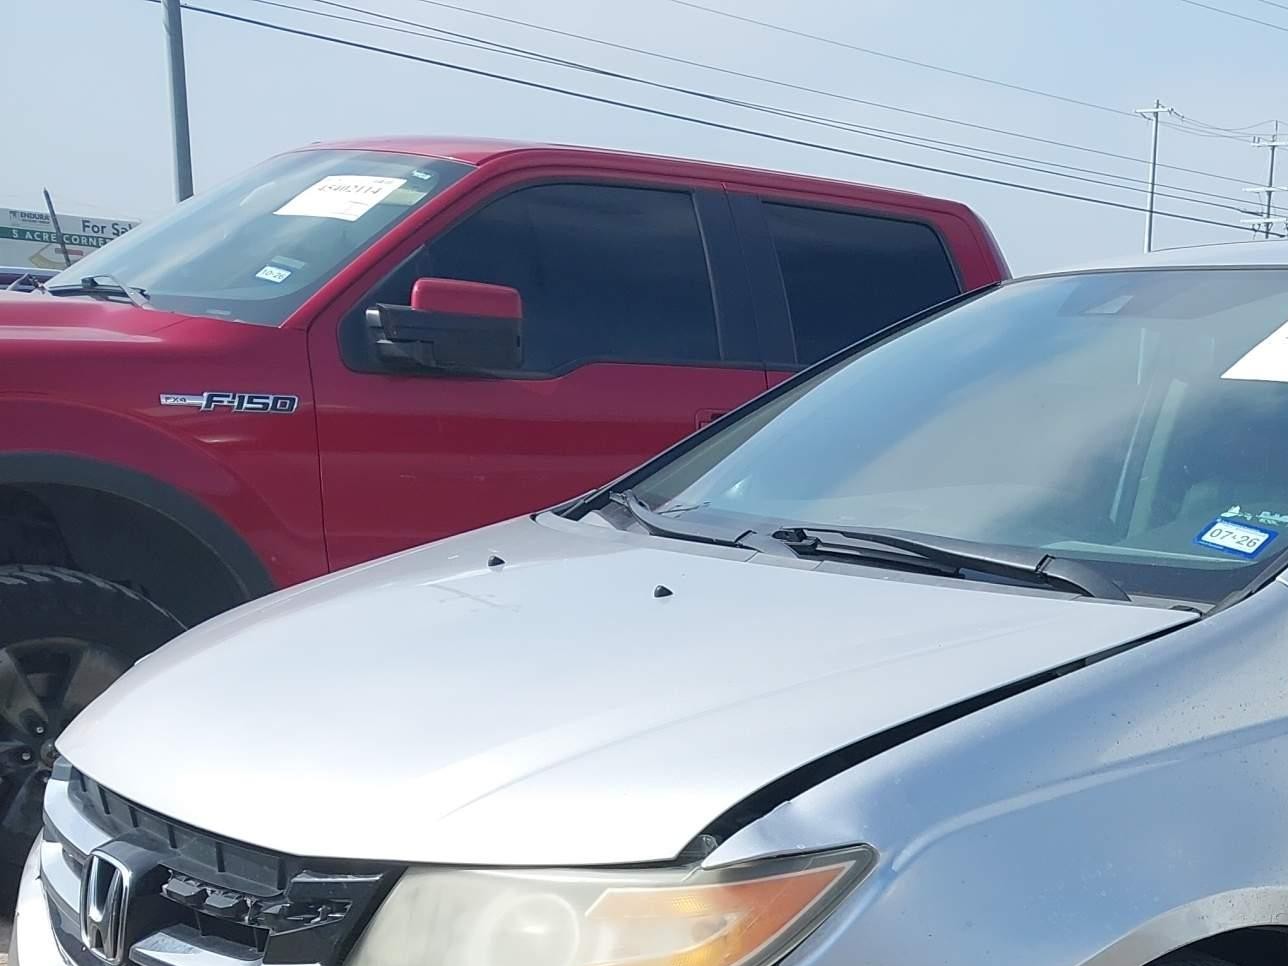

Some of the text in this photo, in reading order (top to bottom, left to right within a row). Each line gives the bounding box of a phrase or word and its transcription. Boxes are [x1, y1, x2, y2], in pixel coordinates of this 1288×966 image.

[81, 219, 107, 234] For
[11, 229, 112, 246] 5 ACRE CORNE
[201, 392, 298, 413] F-150
